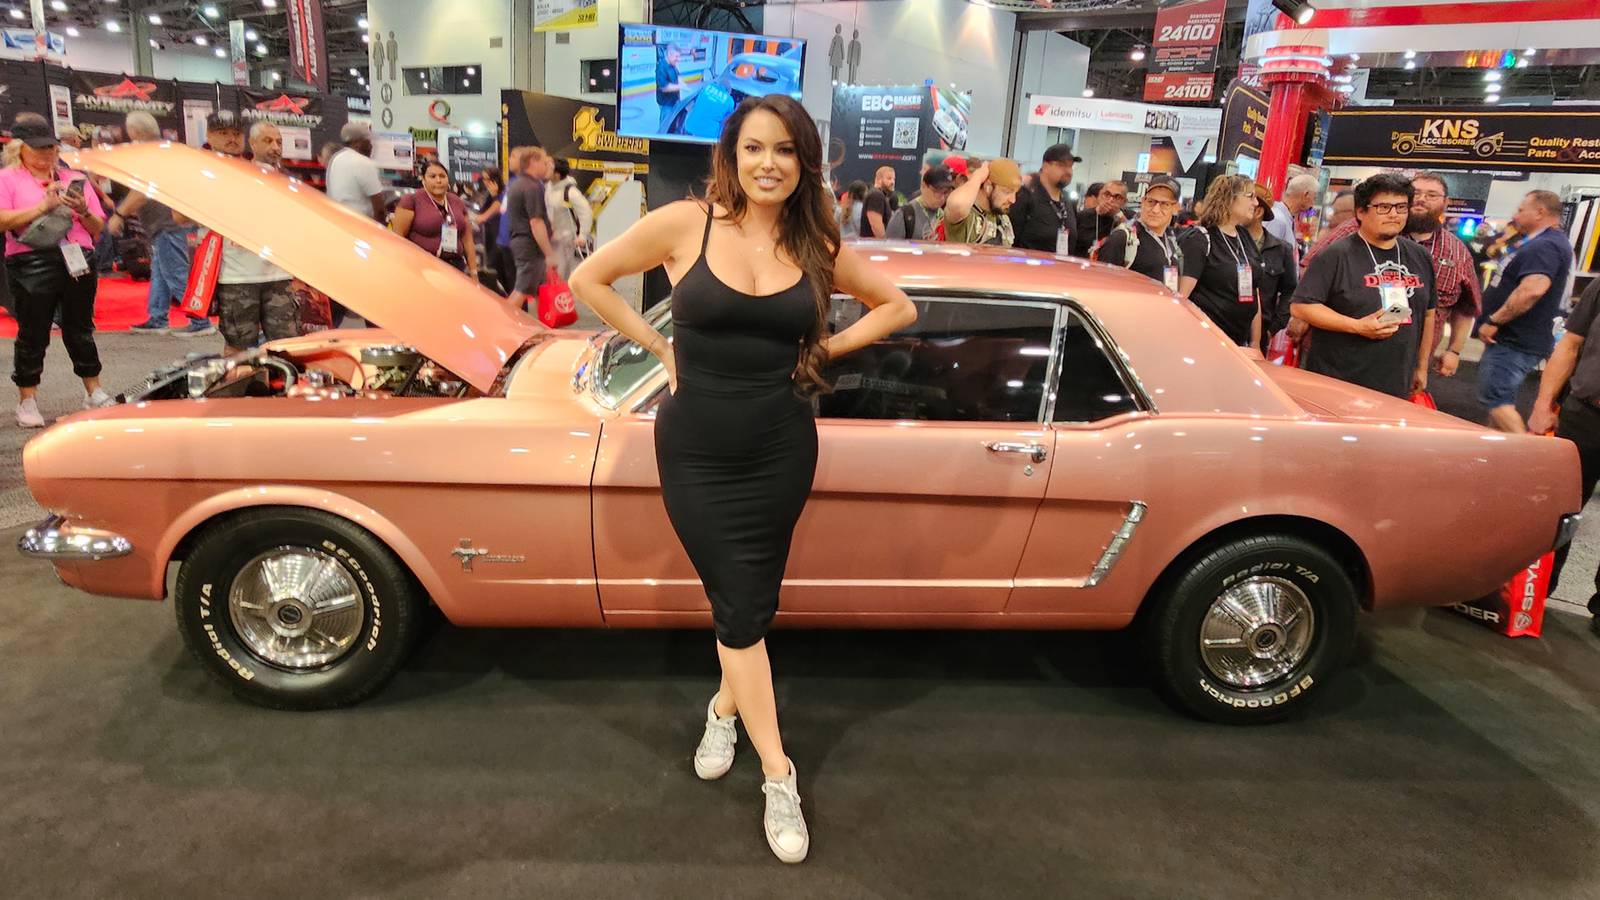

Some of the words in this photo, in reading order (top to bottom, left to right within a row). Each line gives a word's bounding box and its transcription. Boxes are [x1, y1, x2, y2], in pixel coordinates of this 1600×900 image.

[1158, 24, 1216, 42] 24100
[1164, 85, 1212, 98] 24100
[862, 95, 893, 111] EBC
[1050, 107, 1092, 119] idemitsu
[1422, 119, 1480, 139] KNS
[1530, 137, 1571, 148] Quality
[1527, 149, 1557, 158] Parts
[1222, 561, 1291, 587] Radial
[1294, 565, 1320, 584] T/A
[200, 583, 213, 619] T/A
[322, 540, 382, 652] BFGoodrich
[203, 624, 256, 681] Radial
[1200, 674, 1315, 708] BFGoodrich
